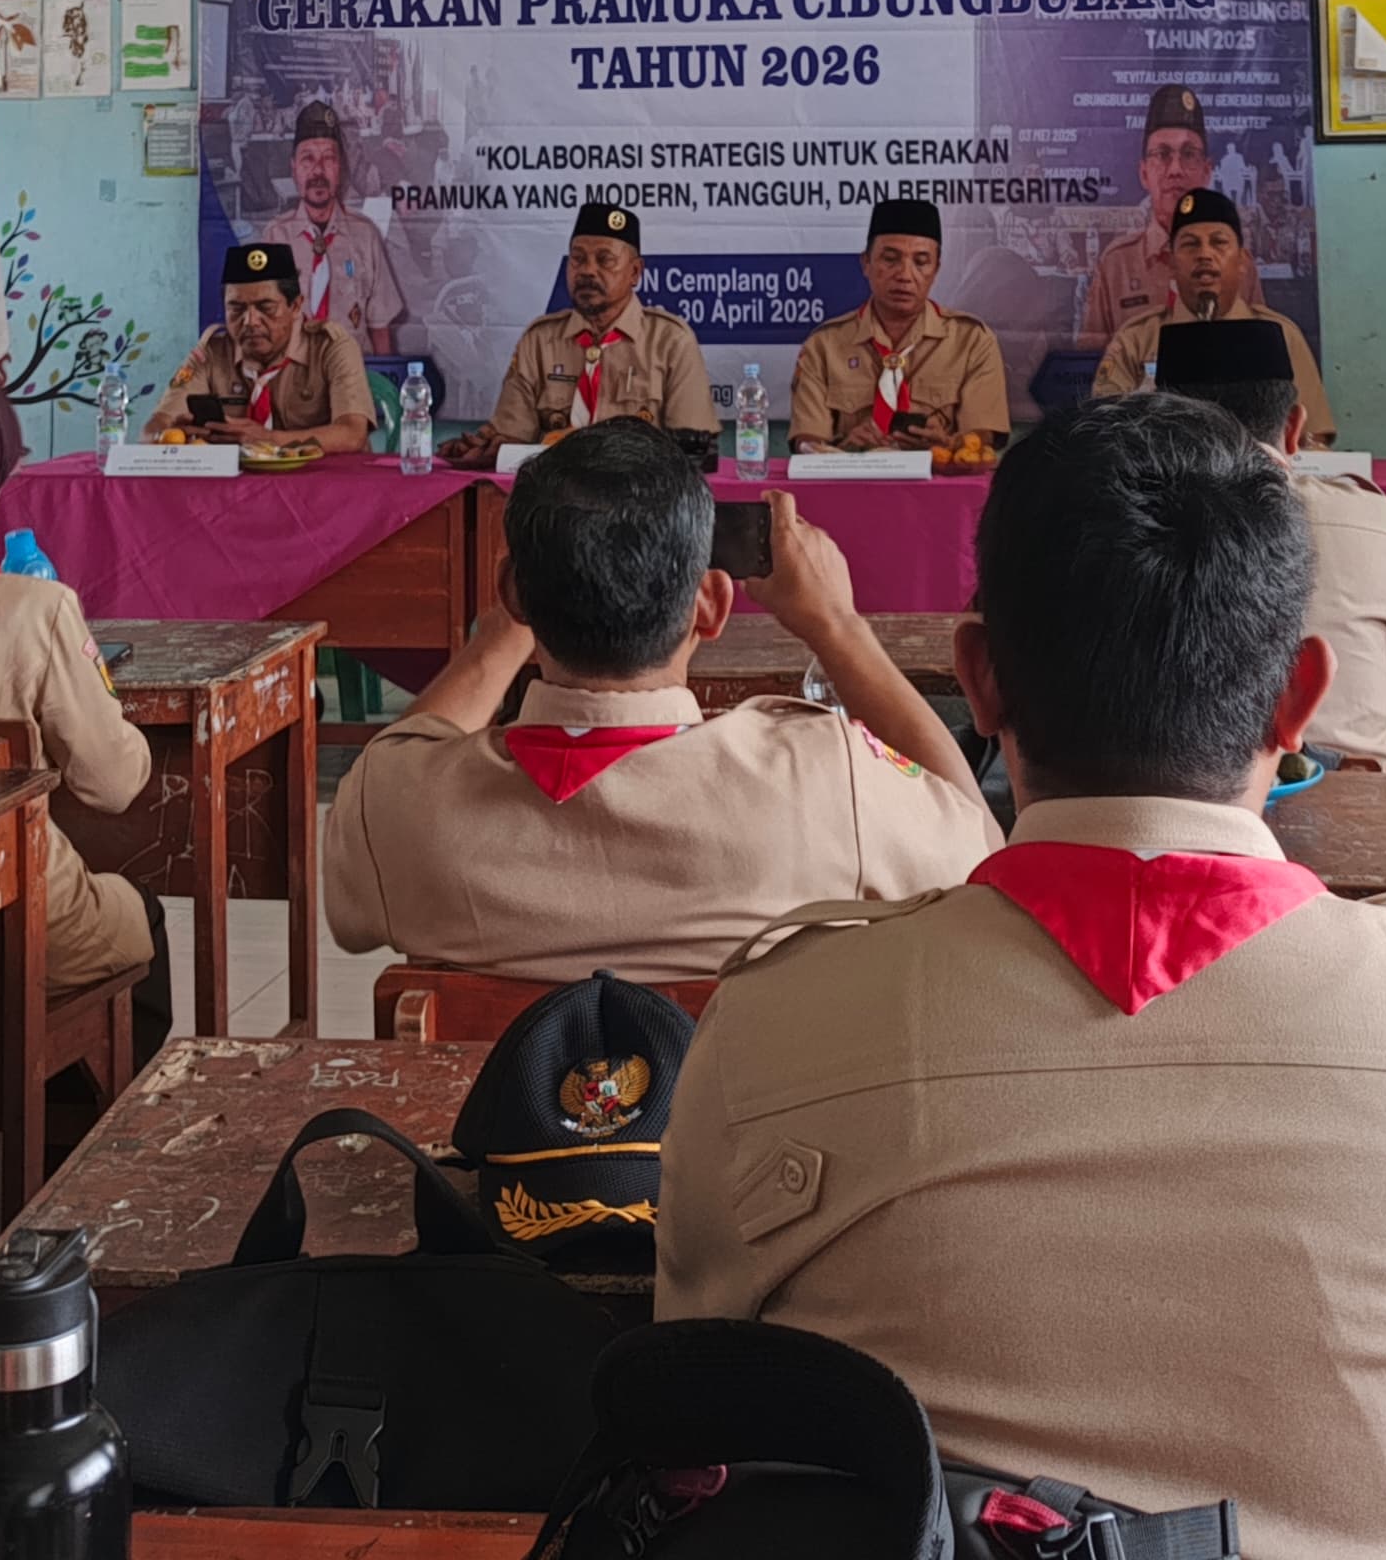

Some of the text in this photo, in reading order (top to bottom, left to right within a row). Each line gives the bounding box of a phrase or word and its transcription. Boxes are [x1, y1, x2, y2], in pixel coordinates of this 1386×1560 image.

[1145, 28, 1257, 50] TAHUN 2025
[571, 44, 880, 89] TAHUN 2026
[650, 142, 785, 168] STRATEGIS
[793, 140, 878, 167] UNTUK
[885, 139, 1009, 165] GERAKAN
[392, 184, 509, 210] PRAMUKA
[512, 183, 578, 209] YANG
[585, 182, 698, 212] MODERN,
[703, 180, 831, 211] TANGGUH,
[838, 180, 889, 206] DAN
[666, 267, 779, 298] Cemplang
[785, 267, 813, 292] 04
[678, 299, 705, 324] 30
[709, 298, 763, 329] April
[770, 298, 825, 324] 2026
